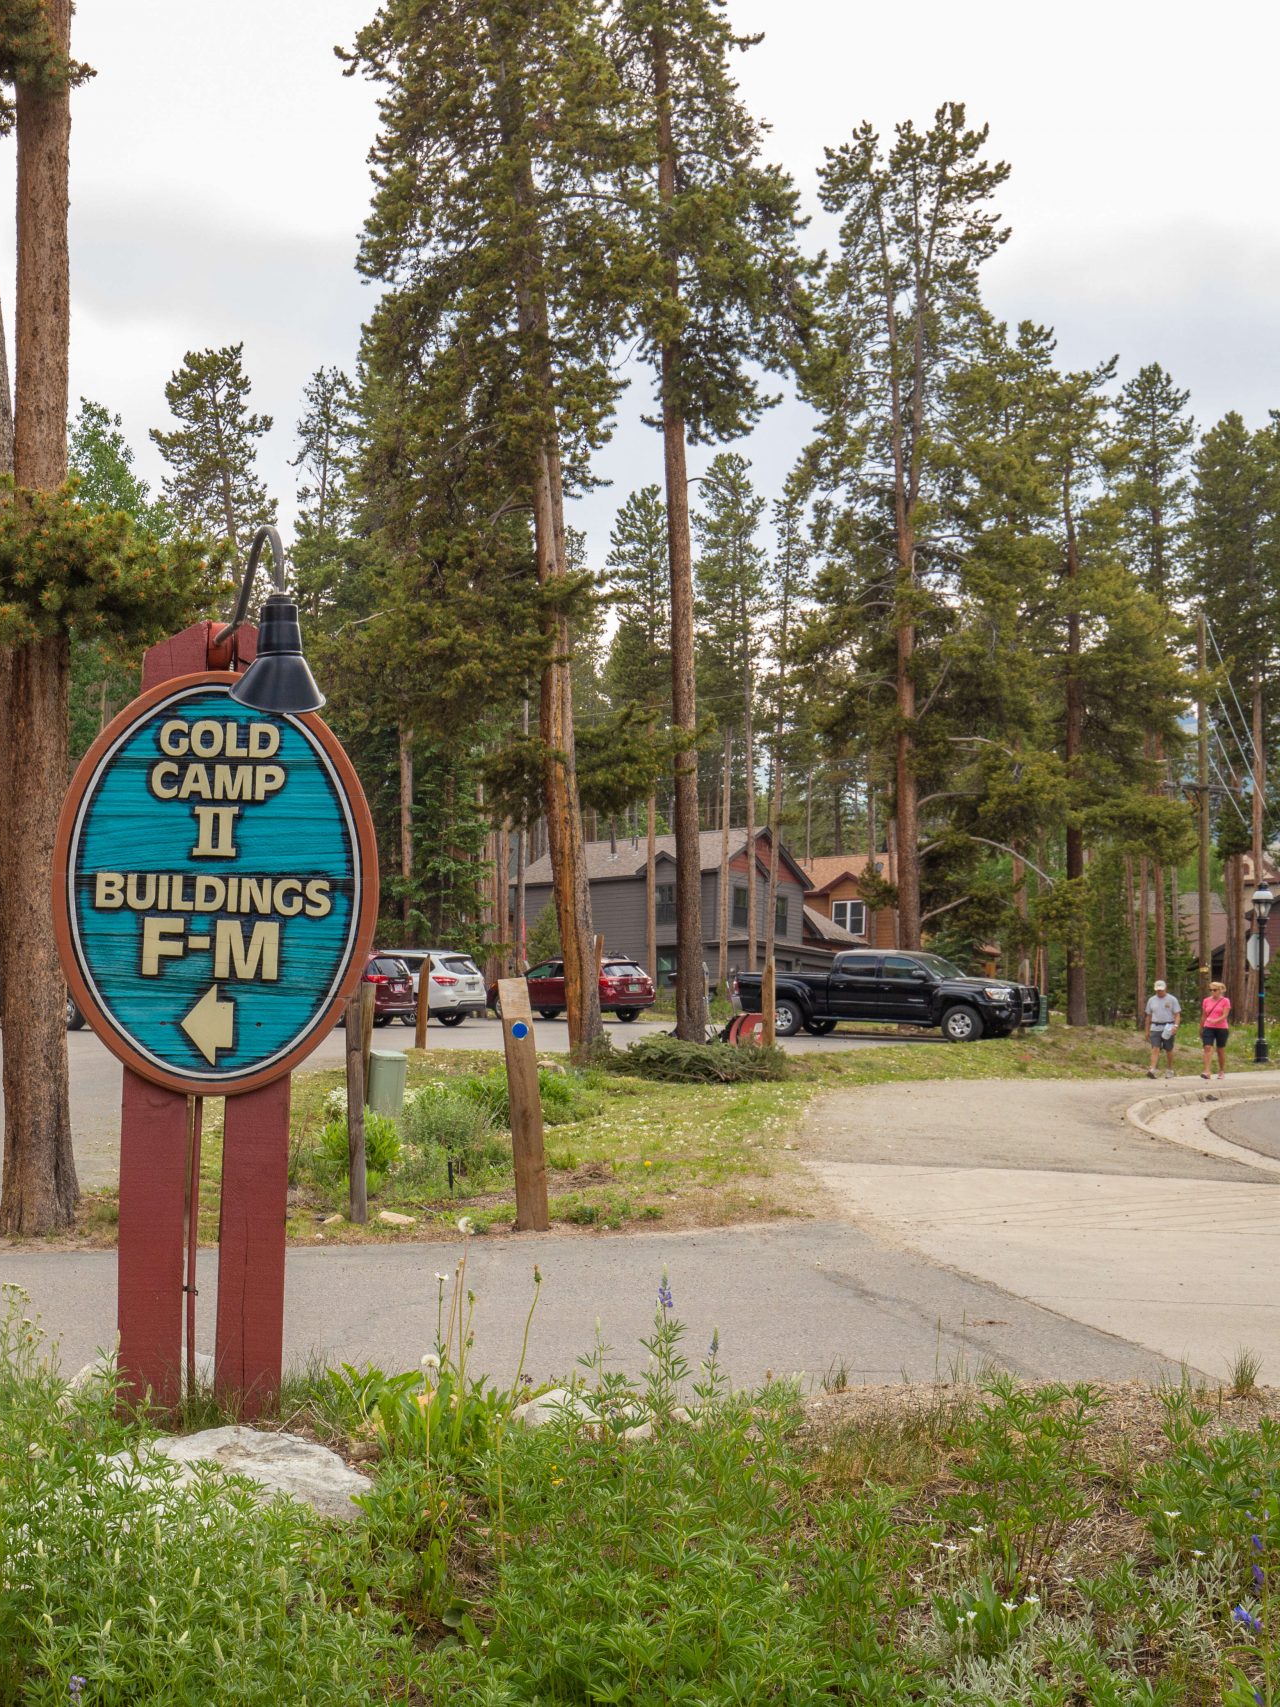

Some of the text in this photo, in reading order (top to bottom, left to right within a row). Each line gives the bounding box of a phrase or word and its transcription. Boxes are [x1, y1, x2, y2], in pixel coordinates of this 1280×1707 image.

[160, 719, 280, 758] GOLD
[151, 761, 286, 801] CAMP
[191, 806, 239, 857] II
[95, 872, 332, 917] BUILDINGS
[141, 917, 280, 981] F-M
